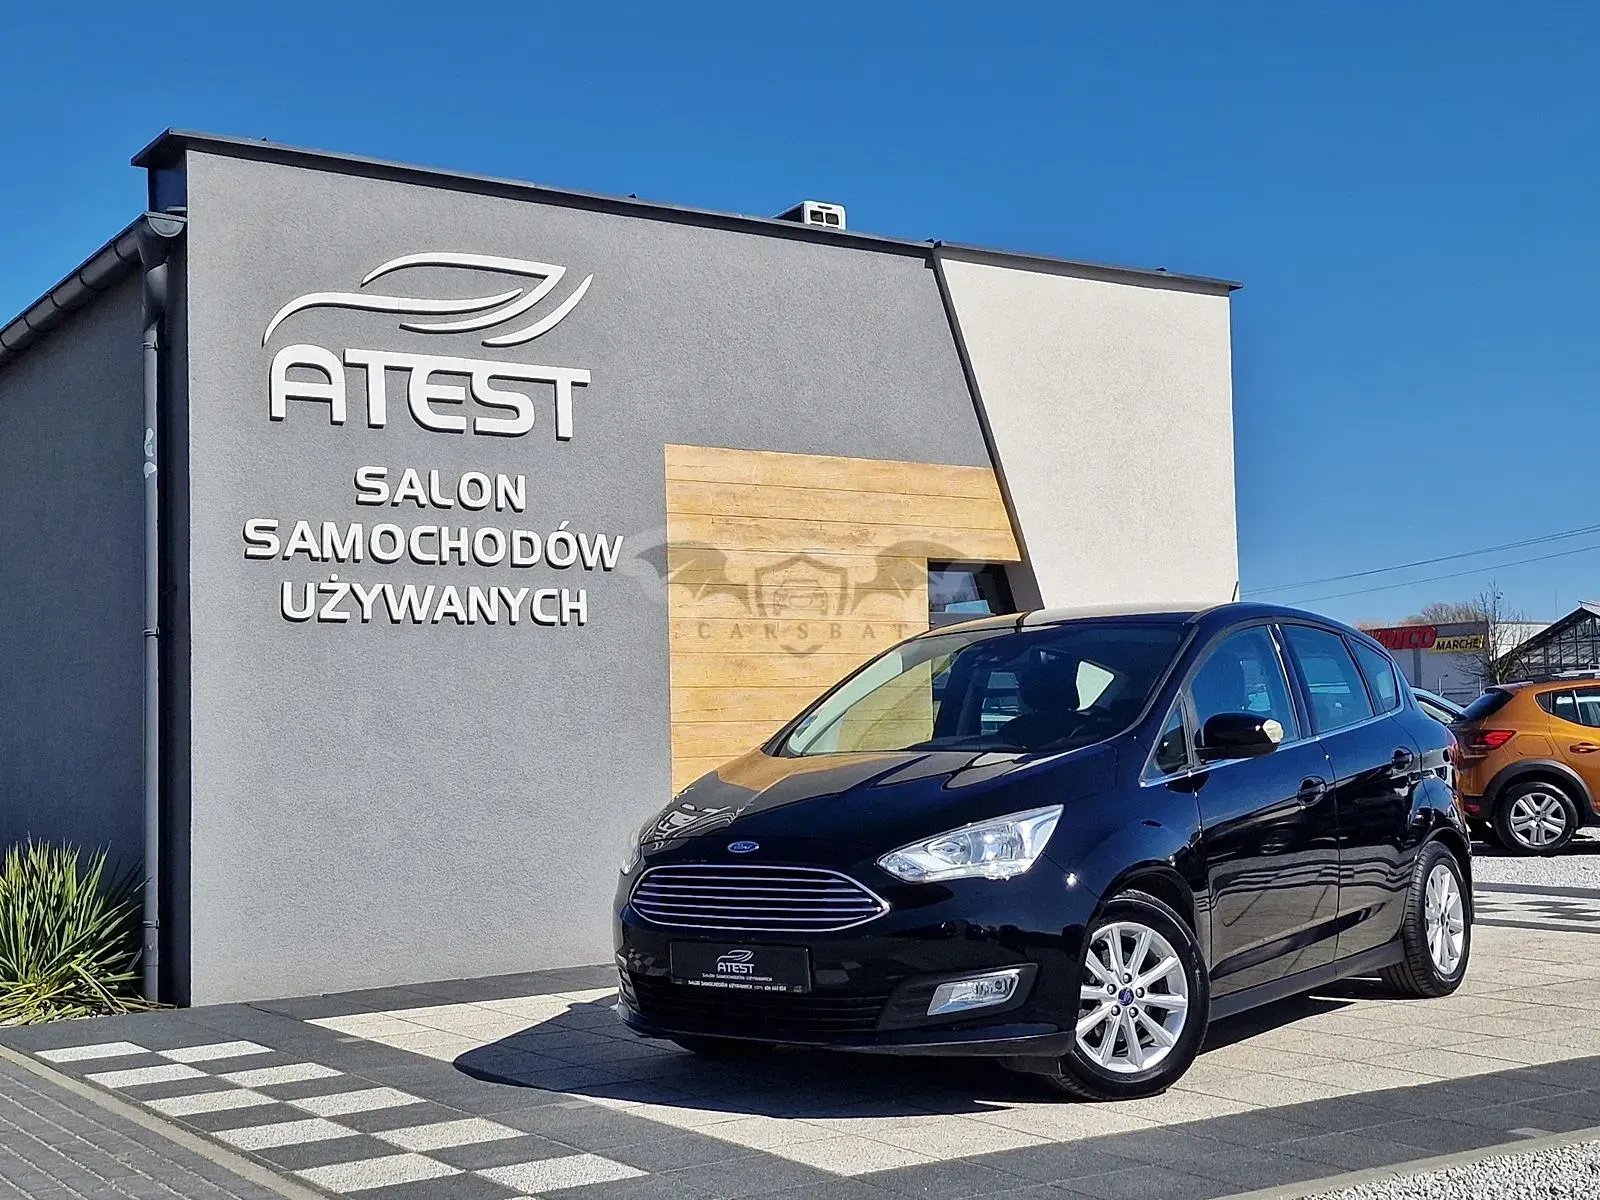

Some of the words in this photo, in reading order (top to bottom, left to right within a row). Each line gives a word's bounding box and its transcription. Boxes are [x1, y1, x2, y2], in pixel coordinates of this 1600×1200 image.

[269, 344, 591, 441] ATEST
[354, 465, 526, 512] SALON
[243, 519, 623, 571] SAMOCHODÓW
[280, 574, 587, 626] UŻYWANYCH
[1368, 627, 1435, 649] RICO
[717, 962, 755, 974] ATEST
